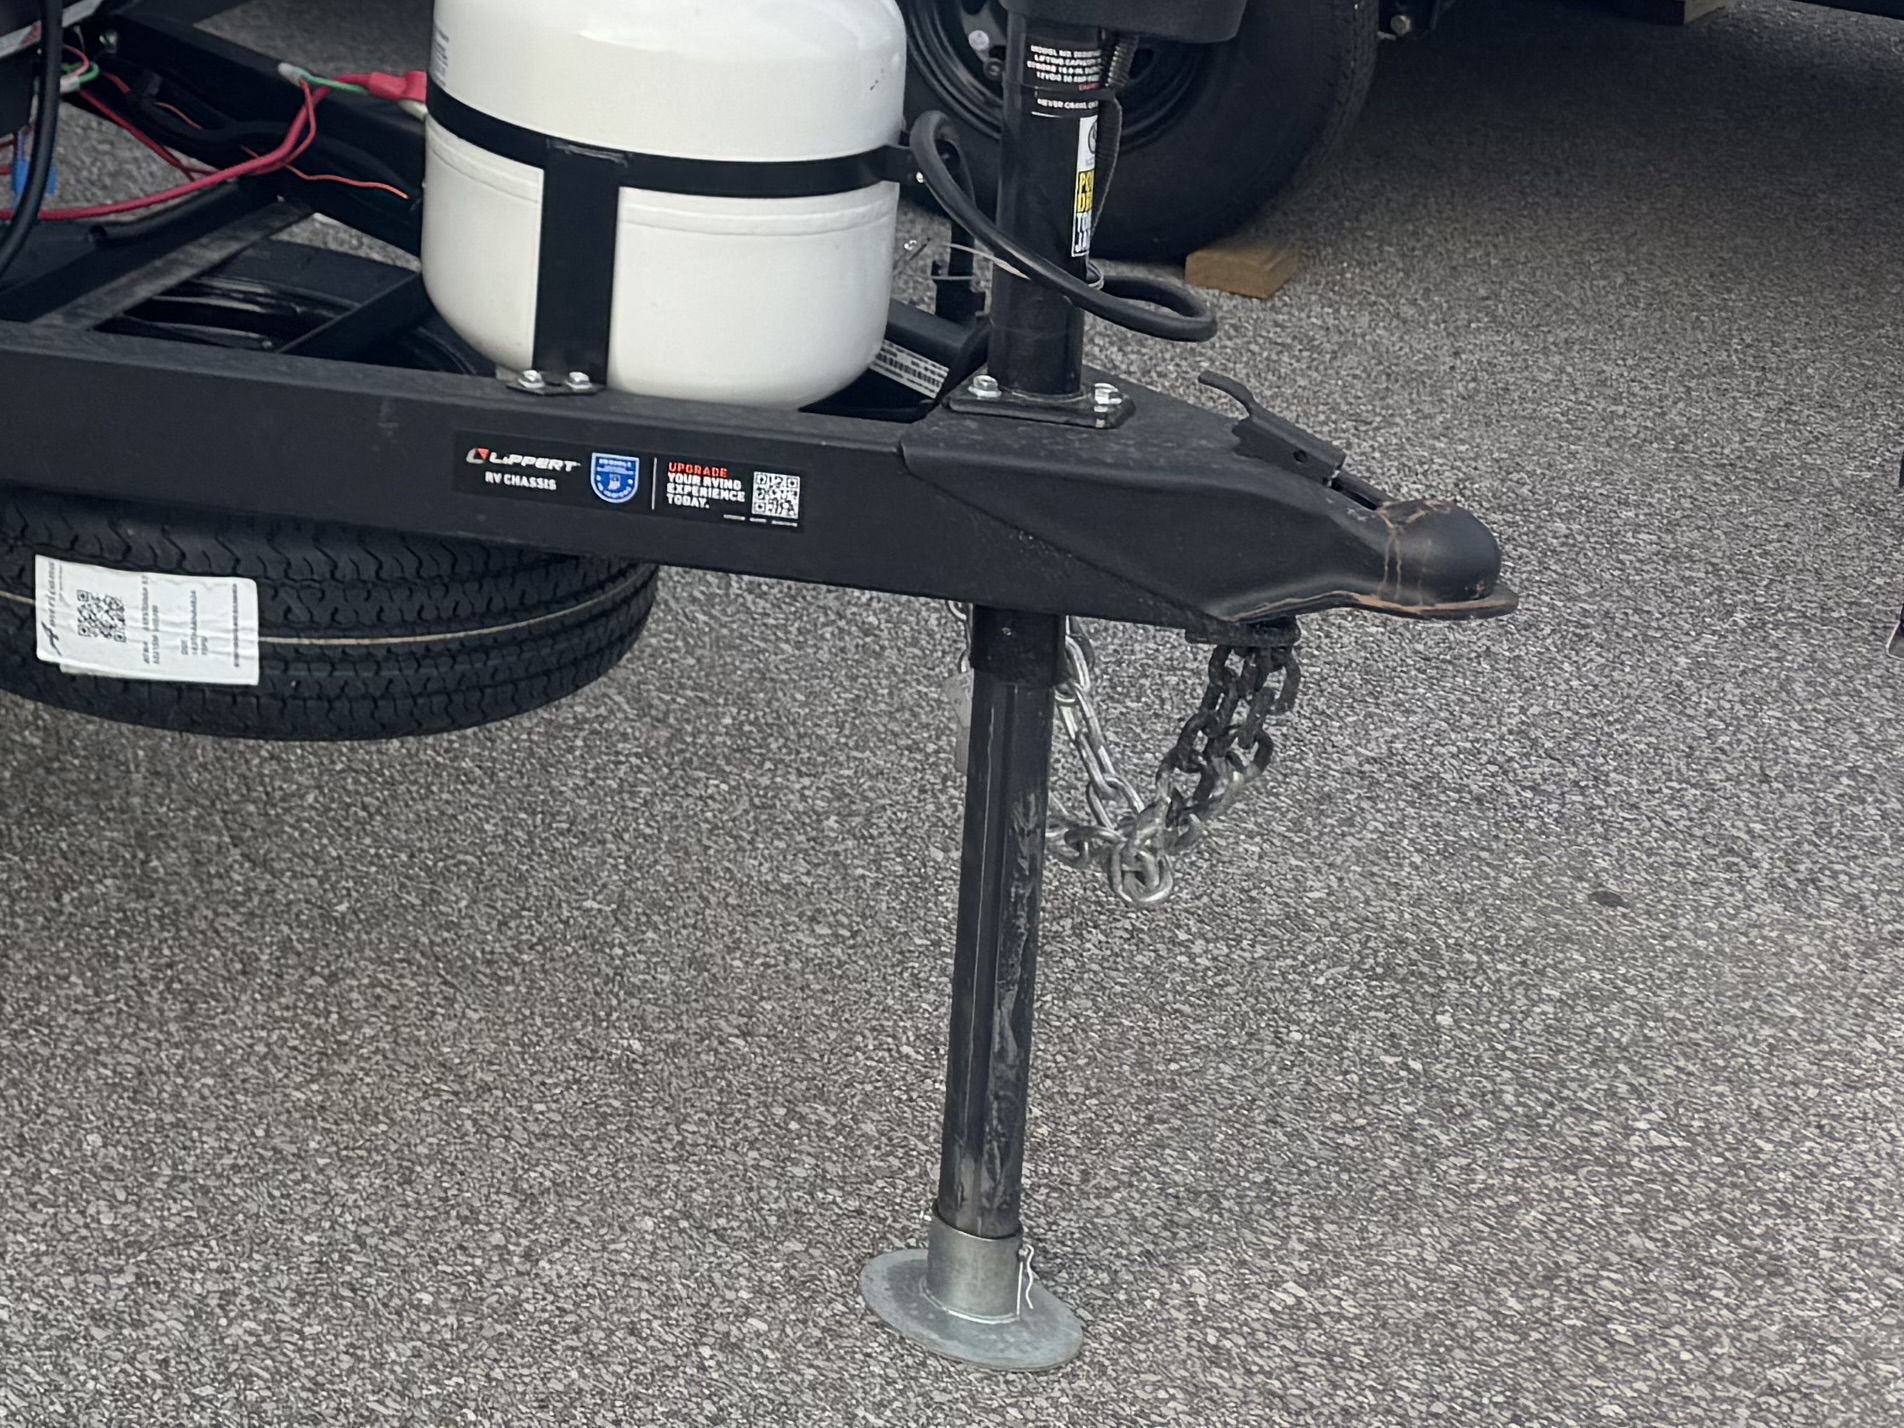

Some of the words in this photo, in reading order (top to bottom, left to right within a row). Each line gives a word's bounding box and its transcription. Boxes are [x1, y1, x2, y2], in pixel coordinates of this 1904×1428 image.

[489, 452, 581, 472] LIPPERT
[668, 462, 728, 477] UPGRADE
[485, 471, 501, 483] RV
[503, 474, 557, 490] CHASSIS
[667, 471, 701, 485] YOUR
[666, 482, 746, 502] EXPERIENCE
[666, 493, 710, 509] TODAY.
